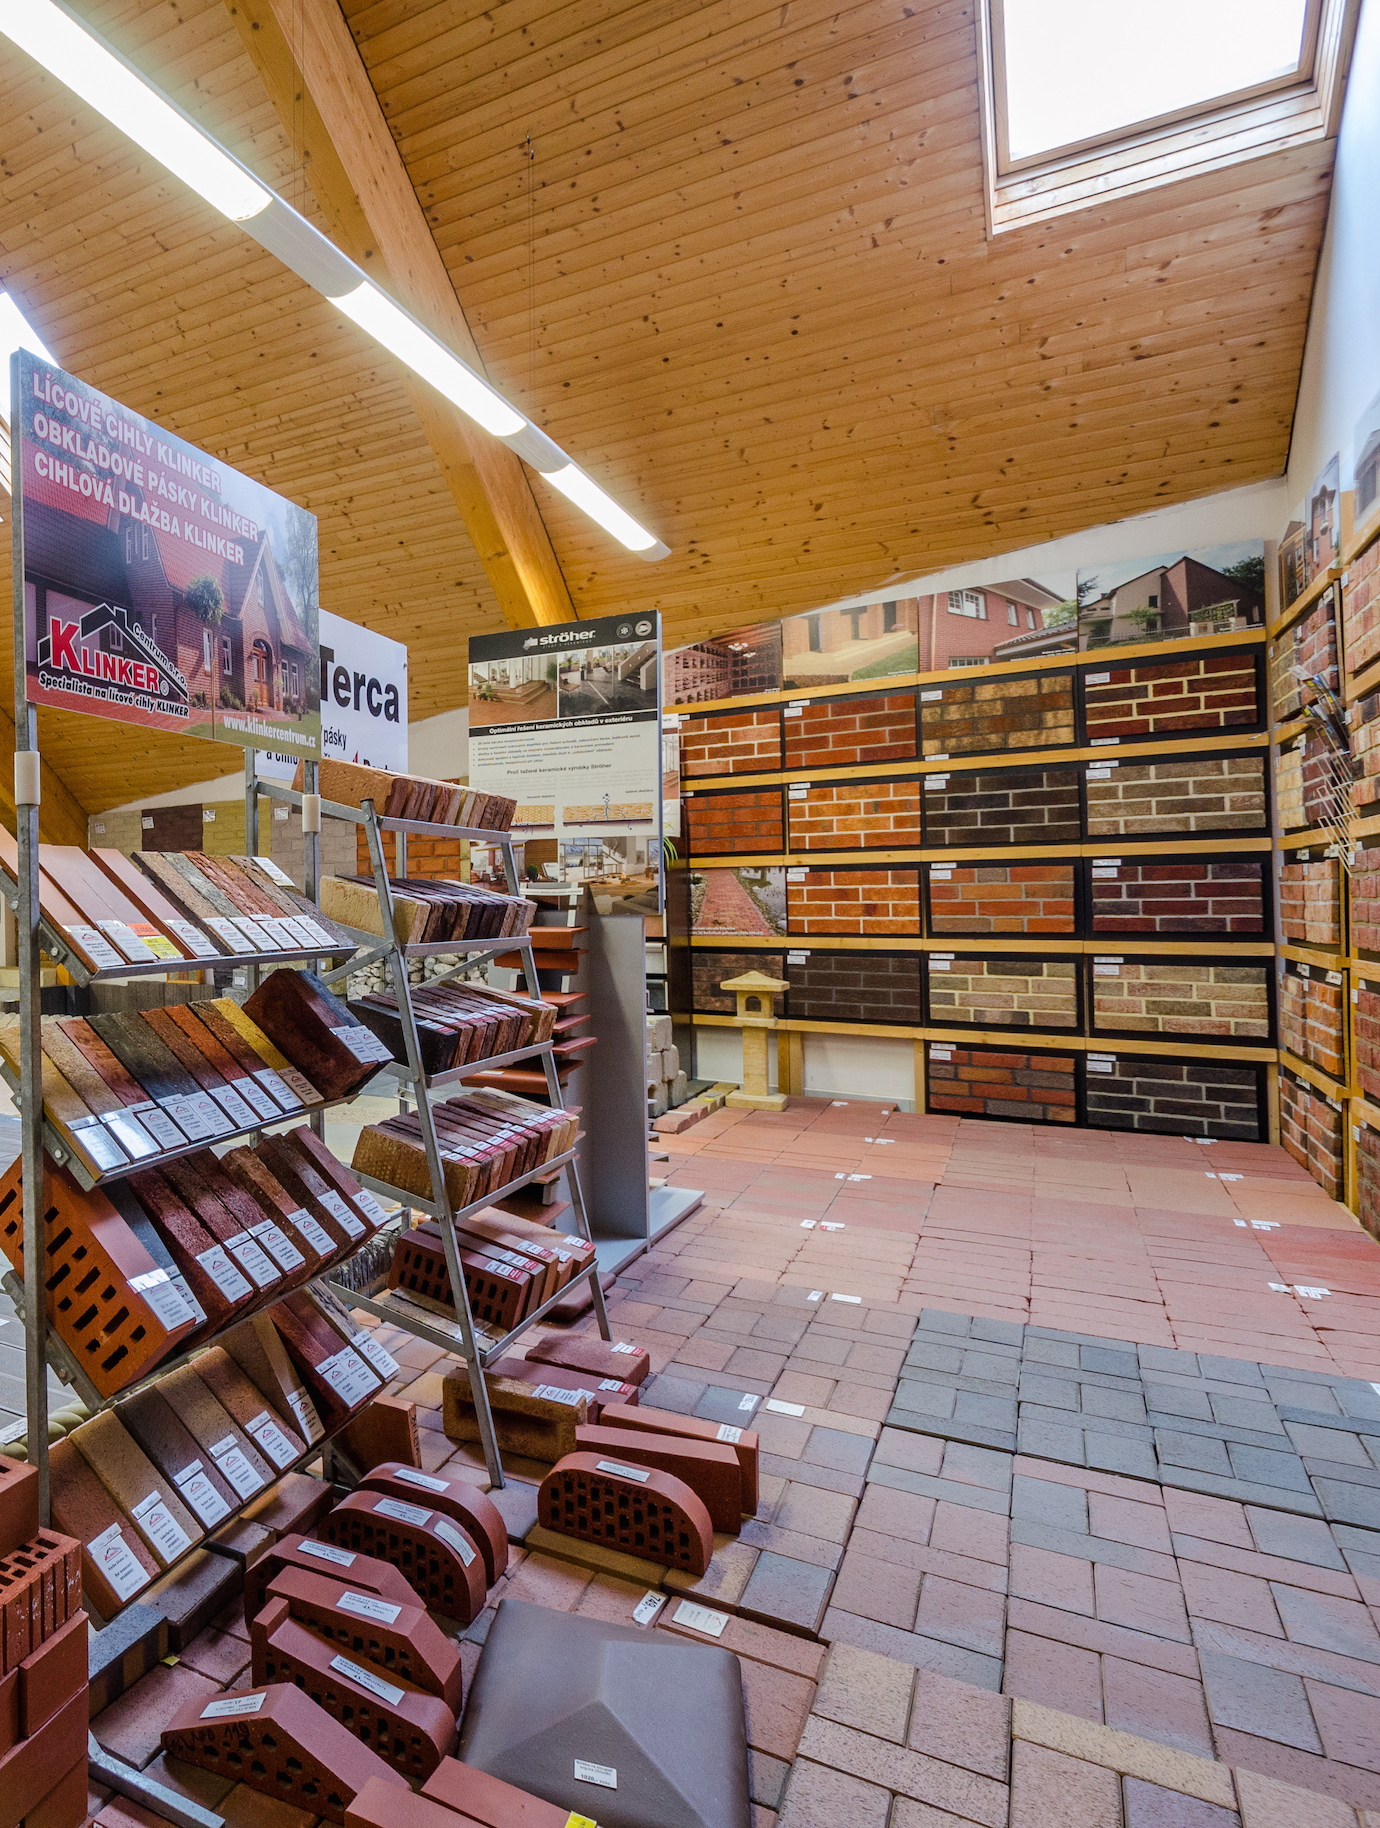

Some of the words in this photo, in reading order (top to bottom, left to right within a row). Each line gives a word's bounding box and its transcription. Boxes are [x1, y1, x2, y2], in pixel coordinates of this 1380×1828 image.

[33, 371, 102, 431] LÍCOVÉ
[106, 413, 154, 456] CIHLY
[157, 442, 222, 494] KLINKER
[33, 412, 144, 486] OBKLADOVÉ
[148, 469, 198, 513] PÁSKY
[201, 496, 259, 543] KLINKER
[34, 452, 115, 509] CIHLOVÁ
[119, 489, 181, 538] DLAŽBA
[184, 520, 245, 566] KLINKER
[50, 616, 160, 694] KLINKER
[133, 622, 170, 667] Centrum
[167, 661, 188, 688] s.r.o.
[539, 629, 595, 646] ströher
[39, 671, 92, 696] Specialista
[94, 685, 107, 699] na
[109, 688, 134, 706] lícové
[135, 695, 155, 714] cihly
[156, 700, 190, 719] KLINKER
[320, 644, 400, 723] Terca
[223, 715, 317, 748] www.klinkercentrum.cz
[323, 727, 347, 751] pásky
[489, 726, 517, 735] Optimální
[517, 724, 535, 732] řešení
[536, 720, 574, 731] keramických
[574, 717, 599, 727] obkladů
[604, 715, 633, 723] exteriéru
[568, 764, 589, 772] výrobky
